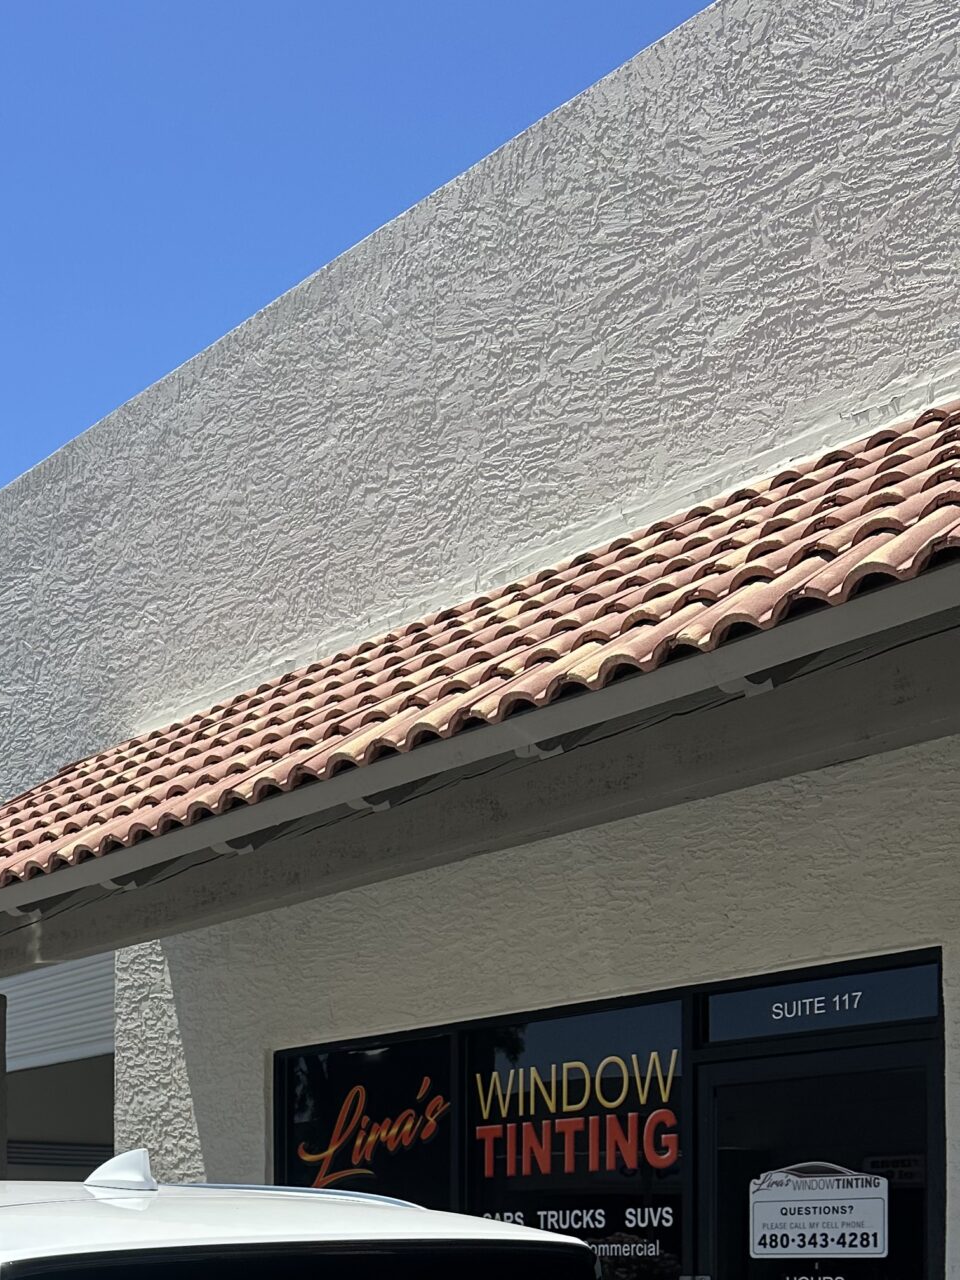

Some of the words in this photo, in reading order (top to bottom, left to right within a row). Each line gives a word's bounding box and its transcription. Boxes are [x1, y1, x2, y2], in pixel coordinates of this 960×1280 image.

[771, 996, 826, 1019] SUITE
[832, 991, 863, 1011] 117
[475, 1049, 679, 1120] WINDOW
[297, 1076, 451, 1187] Lira's
[475, 1108, 680, 1178] TINTING
[537, 1209, 606, 1229] TRUCKS
[625, 1207, 674, 1228] SUVS
[780, 1205, 854, 1216] QUESTIONS?
[762, 1221, 788, 1230] PLEASE
[790, 1221, 807, 1230] CALL
[809, 1221, 820, 1230] MY
[822, 1220, 839, 1229] CELL
[584, 1239, 660, 1257] ommercial
